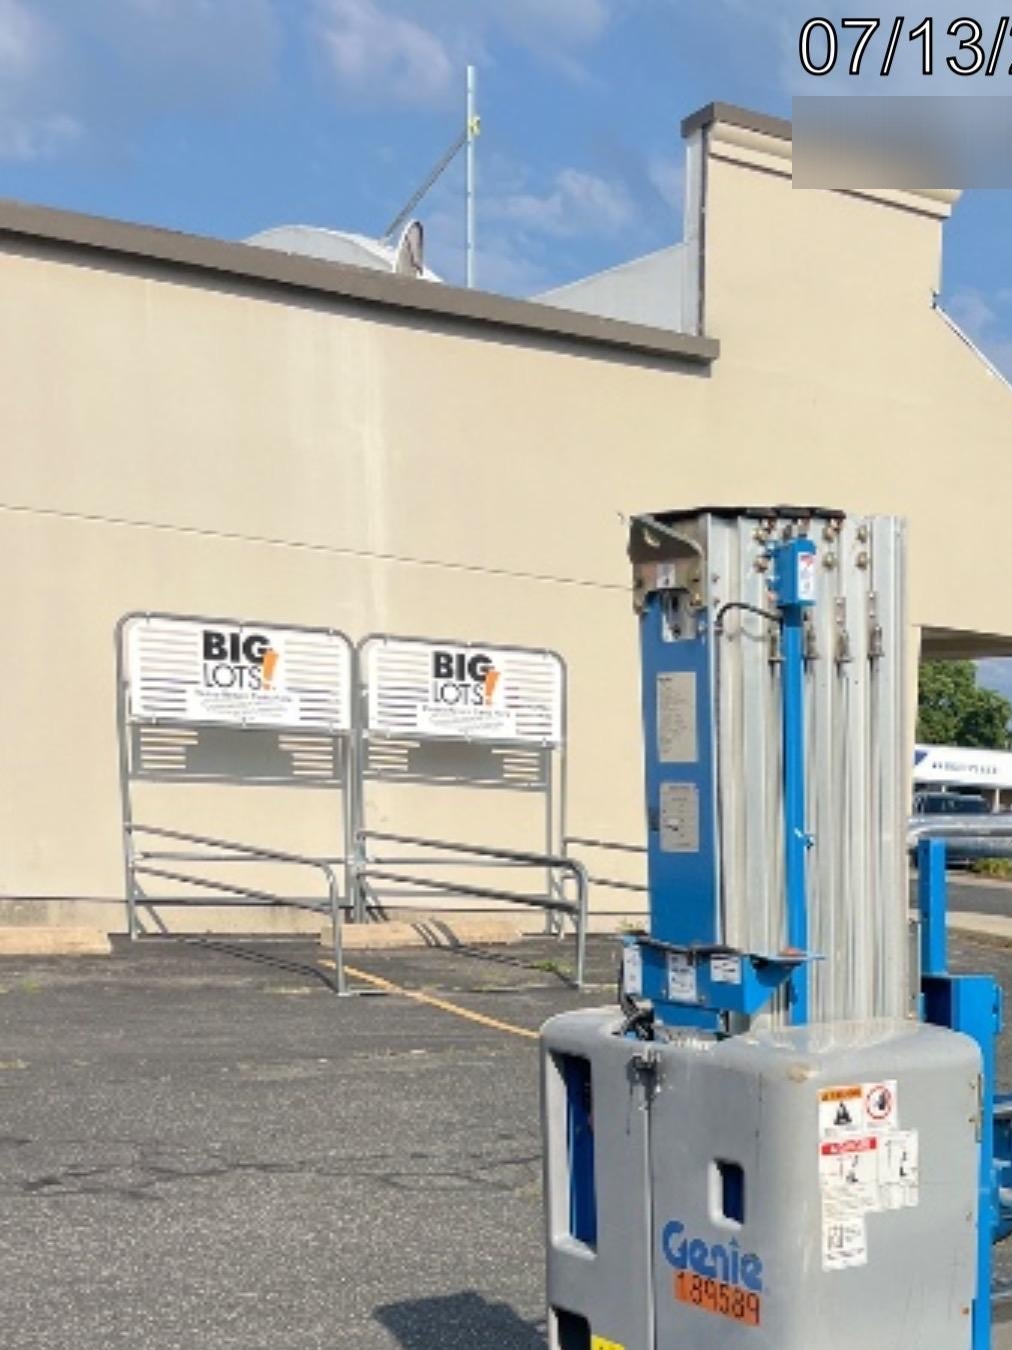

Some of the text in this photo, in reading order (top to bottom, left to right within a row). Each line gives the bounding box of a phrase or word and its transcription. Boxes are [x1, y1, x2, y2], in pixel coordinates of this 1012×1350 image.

[203, 630, 269, 664] BIG
[433, 651, 494, 682] BIG
[662, 1219, 763, 1292] Genie
[676, 1270, 760, 1326] 189589
